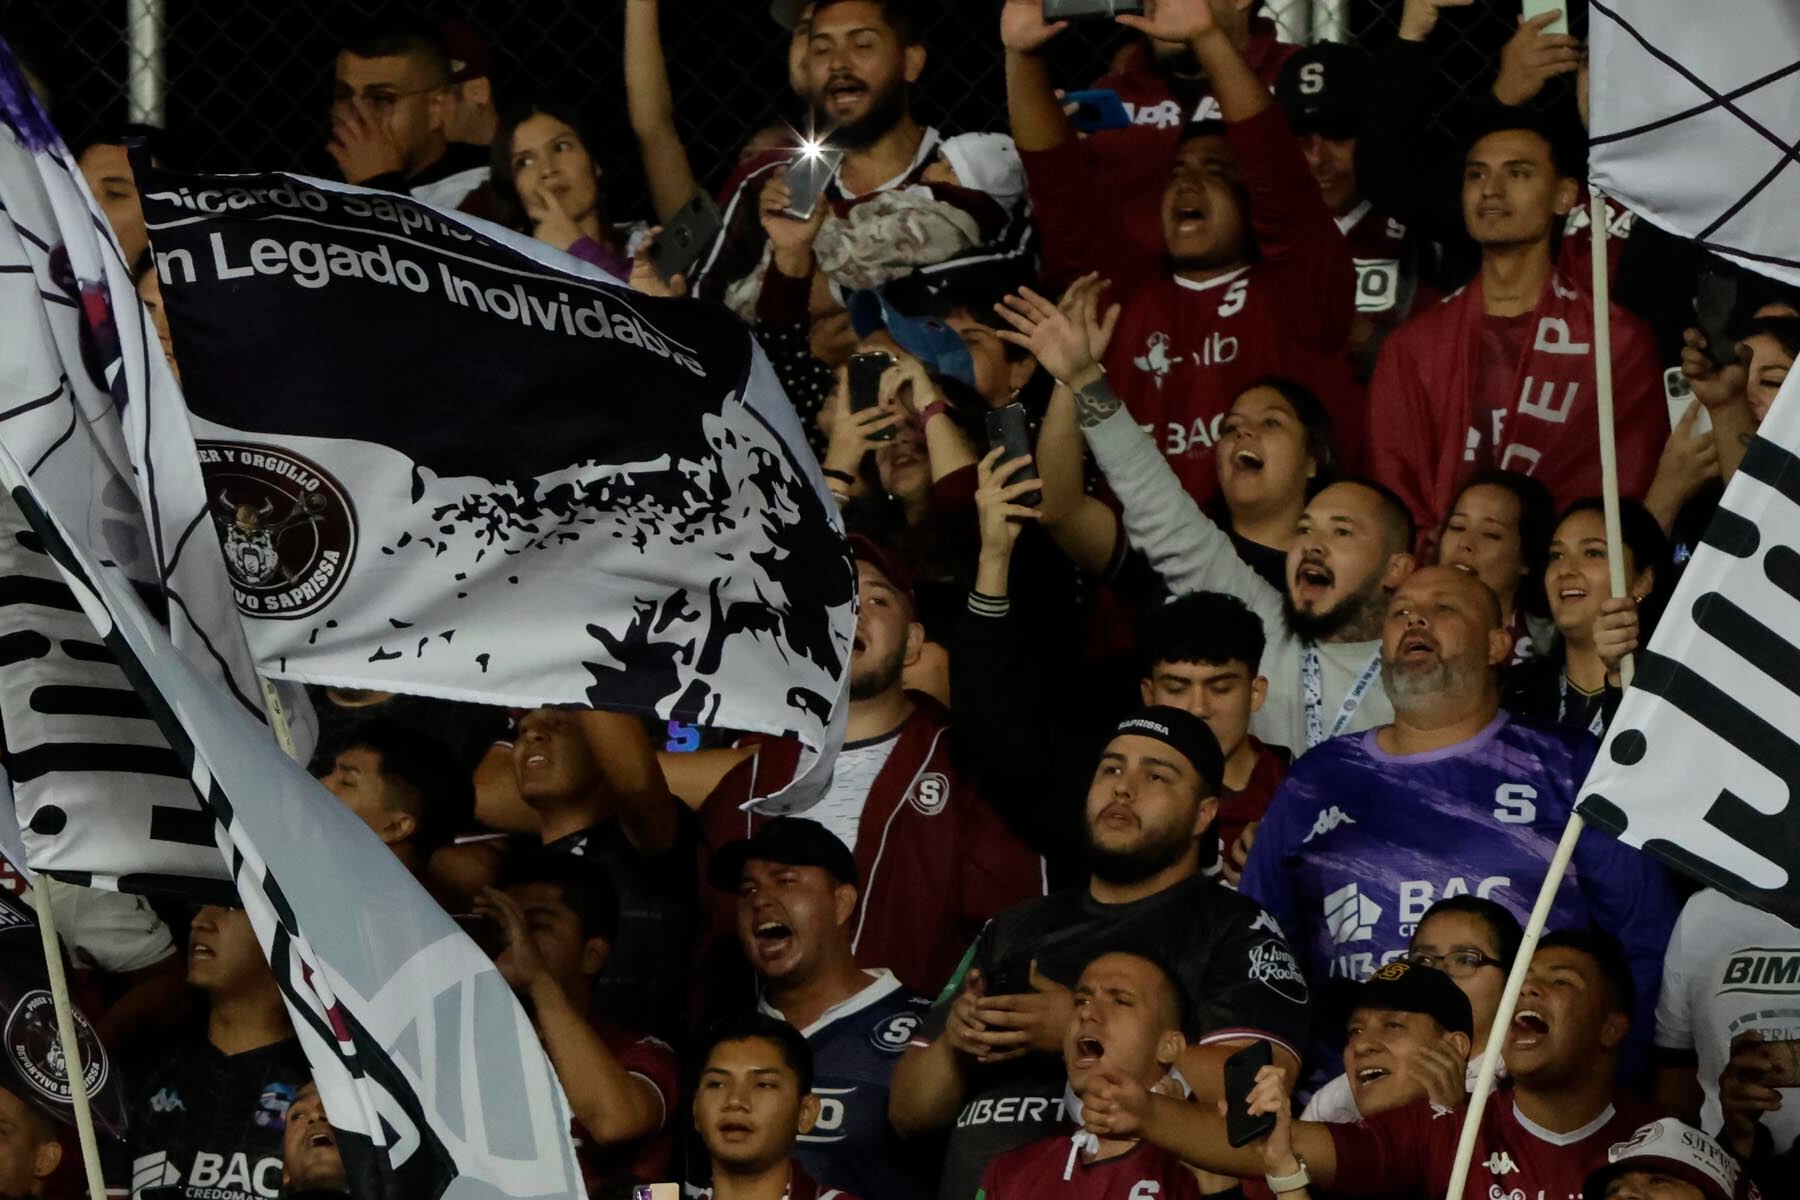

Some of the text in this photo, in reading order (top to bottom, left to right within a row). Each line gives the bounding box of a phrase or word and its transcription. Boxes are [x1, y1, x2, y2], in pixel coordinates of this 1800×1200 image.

[1300, 62, 1325, 94] S
[155, 244, 193, 288] n
[208, 230, 426, 302] Legado
[241, 451, 321, 493] ORGULLO
[266, 546, 342, 614] SAPRISSA
[919, 779, 947, 807] S
[1493, 782, 1539, 825] S
[1721, 962, 1800, 992] BIM
[883, 1017, 918, 1044] S
[955, 1095, 1070, 1128] LIBERT
[187, 1151, 285, 1199] BAC
